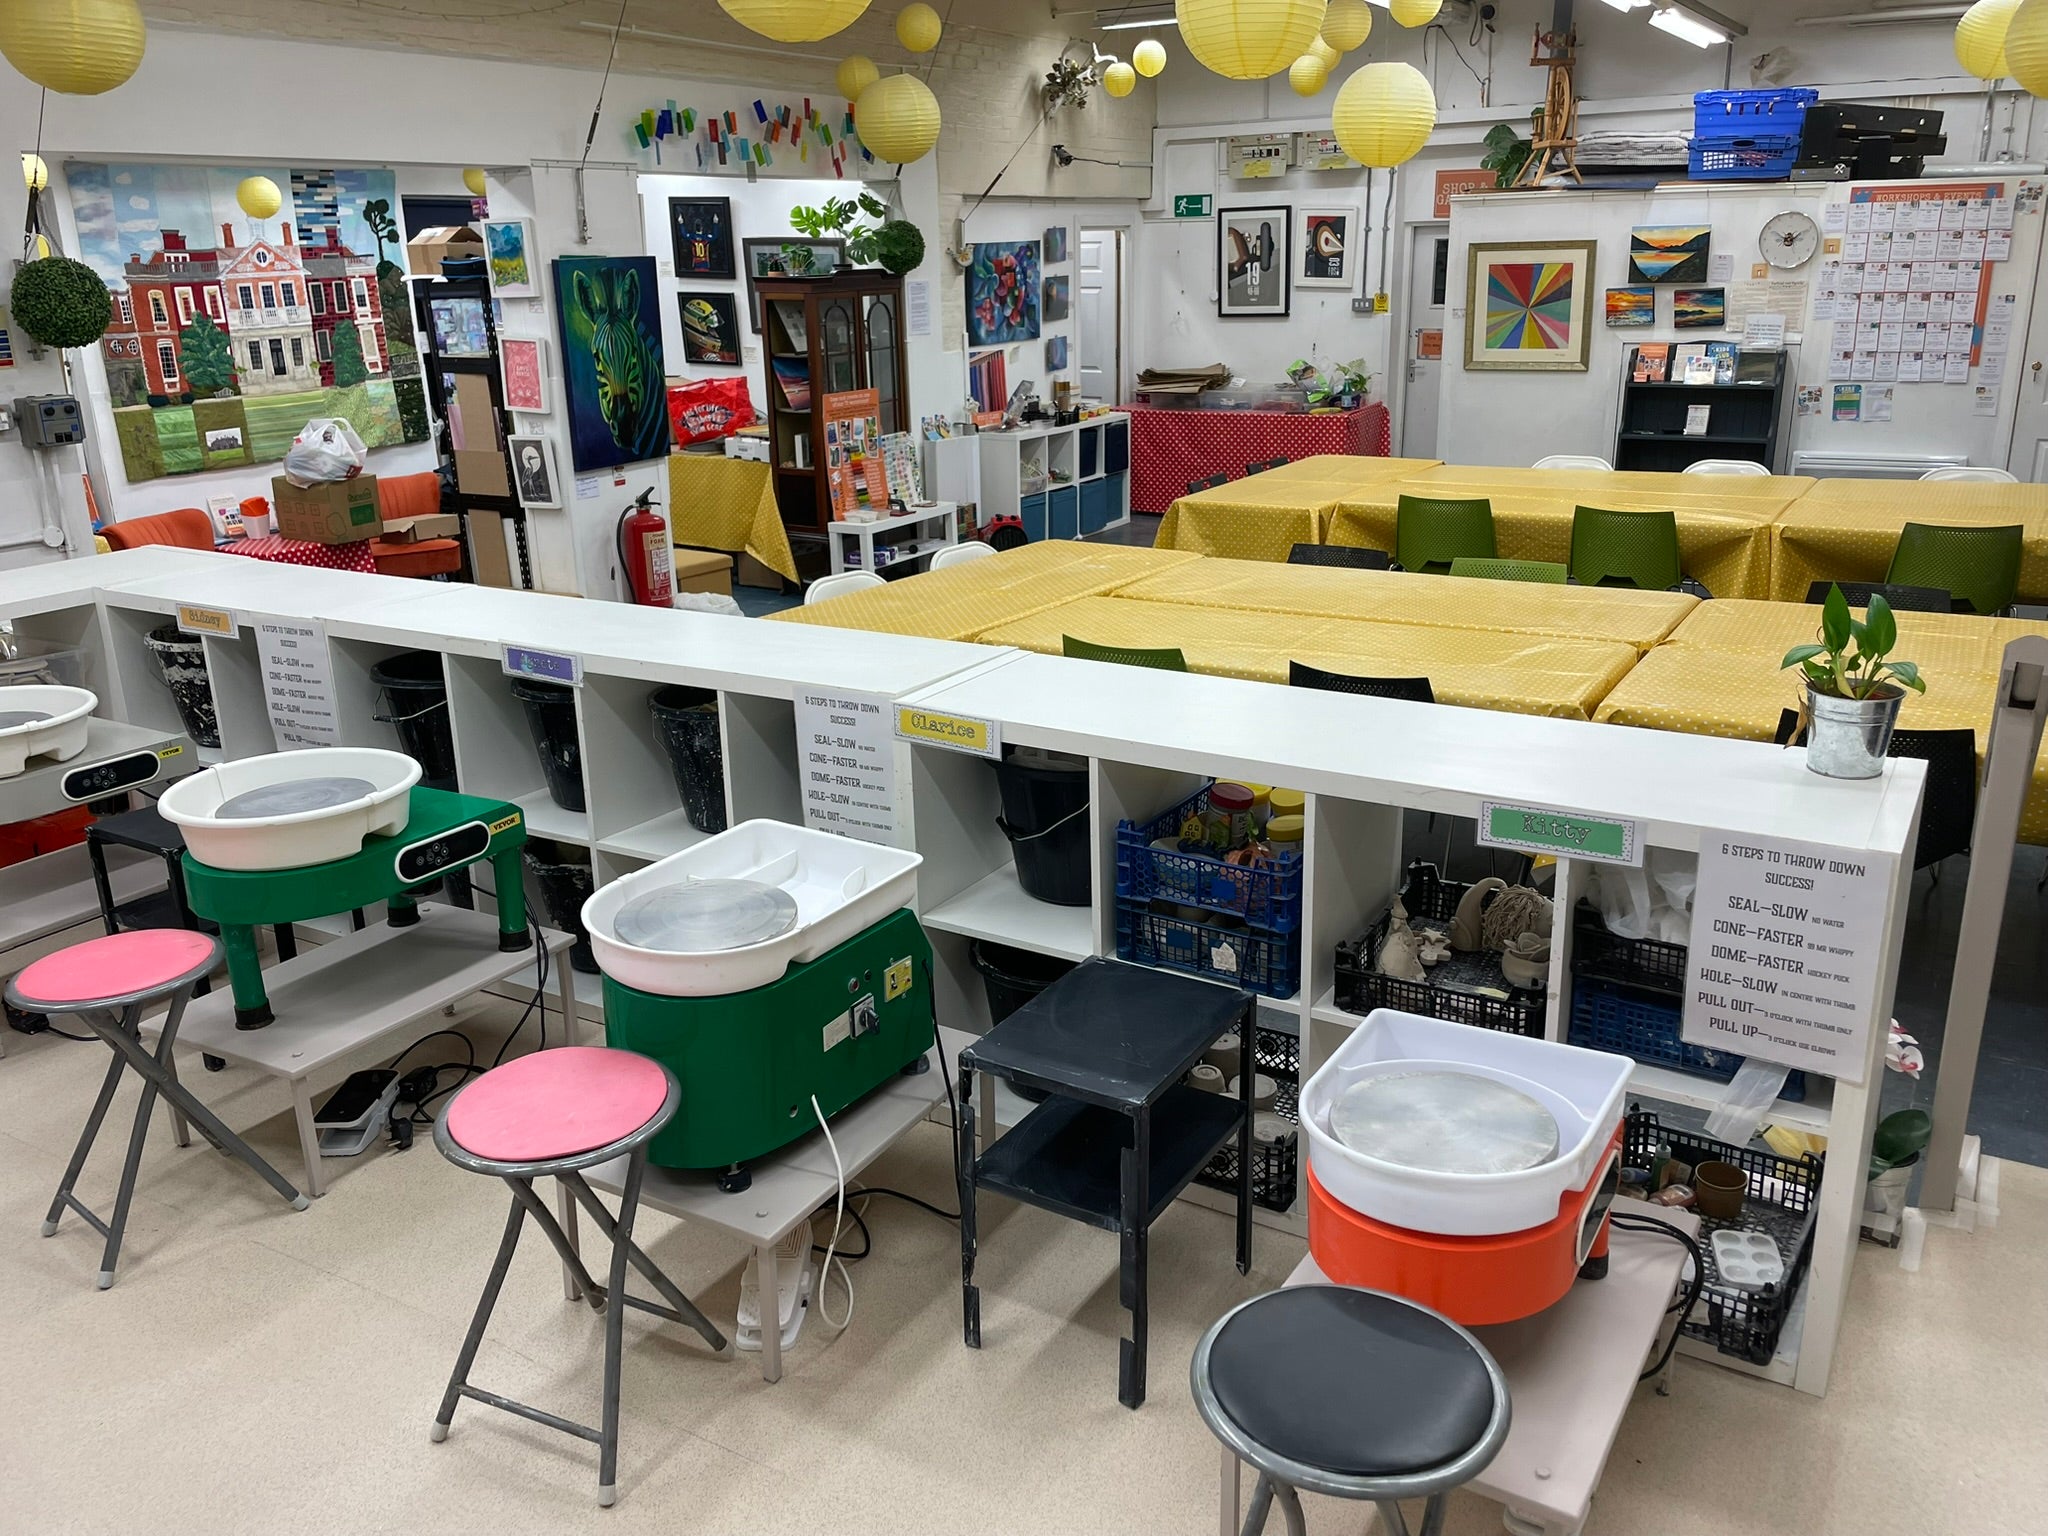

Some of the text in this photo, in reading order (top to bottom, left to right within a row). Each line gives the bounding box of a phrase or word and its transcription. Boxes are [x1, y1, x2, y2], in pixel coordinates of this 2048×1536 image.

[1442, 182, 1475, 194] SHOP
[1876, 191, 1983, 202] WORKSHOPS & EVENTS
[695, 242, 704, 258] 10
[1246, 262, 1261, 286] 19
[810, 696, 828, 707] STEPS
[828, 699, 836, 708] TO
[837, 700, 859, 712] THROW
[860, 703, 880, 714] DOWN
[912, 712, 976, 738] Clarice
[810, 808, 826, 820] PULL
[494, 816, 516, 831] VEVOR
[1522, 814, 1592, 845] Kitty
[1722, 844, 1866, 877] 6 STEPS TO THROW DOWN
[1765, 872, 1814, 891] SUCCESS!
[1812, 916, 1820, 924] NO
[1822, 918, 1846, 929] WATER
[1816, 944, 1828, 954] MR
[1807, 969, 1832, 980] HOCKEY
[1833, 974, 1850, 984] PUCK
[1782, 989, 1789, 998] IN
[1790, 991, 1814, 1002] CENTRE
[1815, 994, 1832, 1006] WITH
[1833, 998, 1856, 1010] THUMB
[1698, 991, 1727, 1008] PULL
[1795, 1016, 1812, 1028] WITH
[1814, 1021, 1836, 1032] THUMB
[1836, 1026, 1854, 1036] ONLY
[1709, 1016, 1738, 1034] PULL
